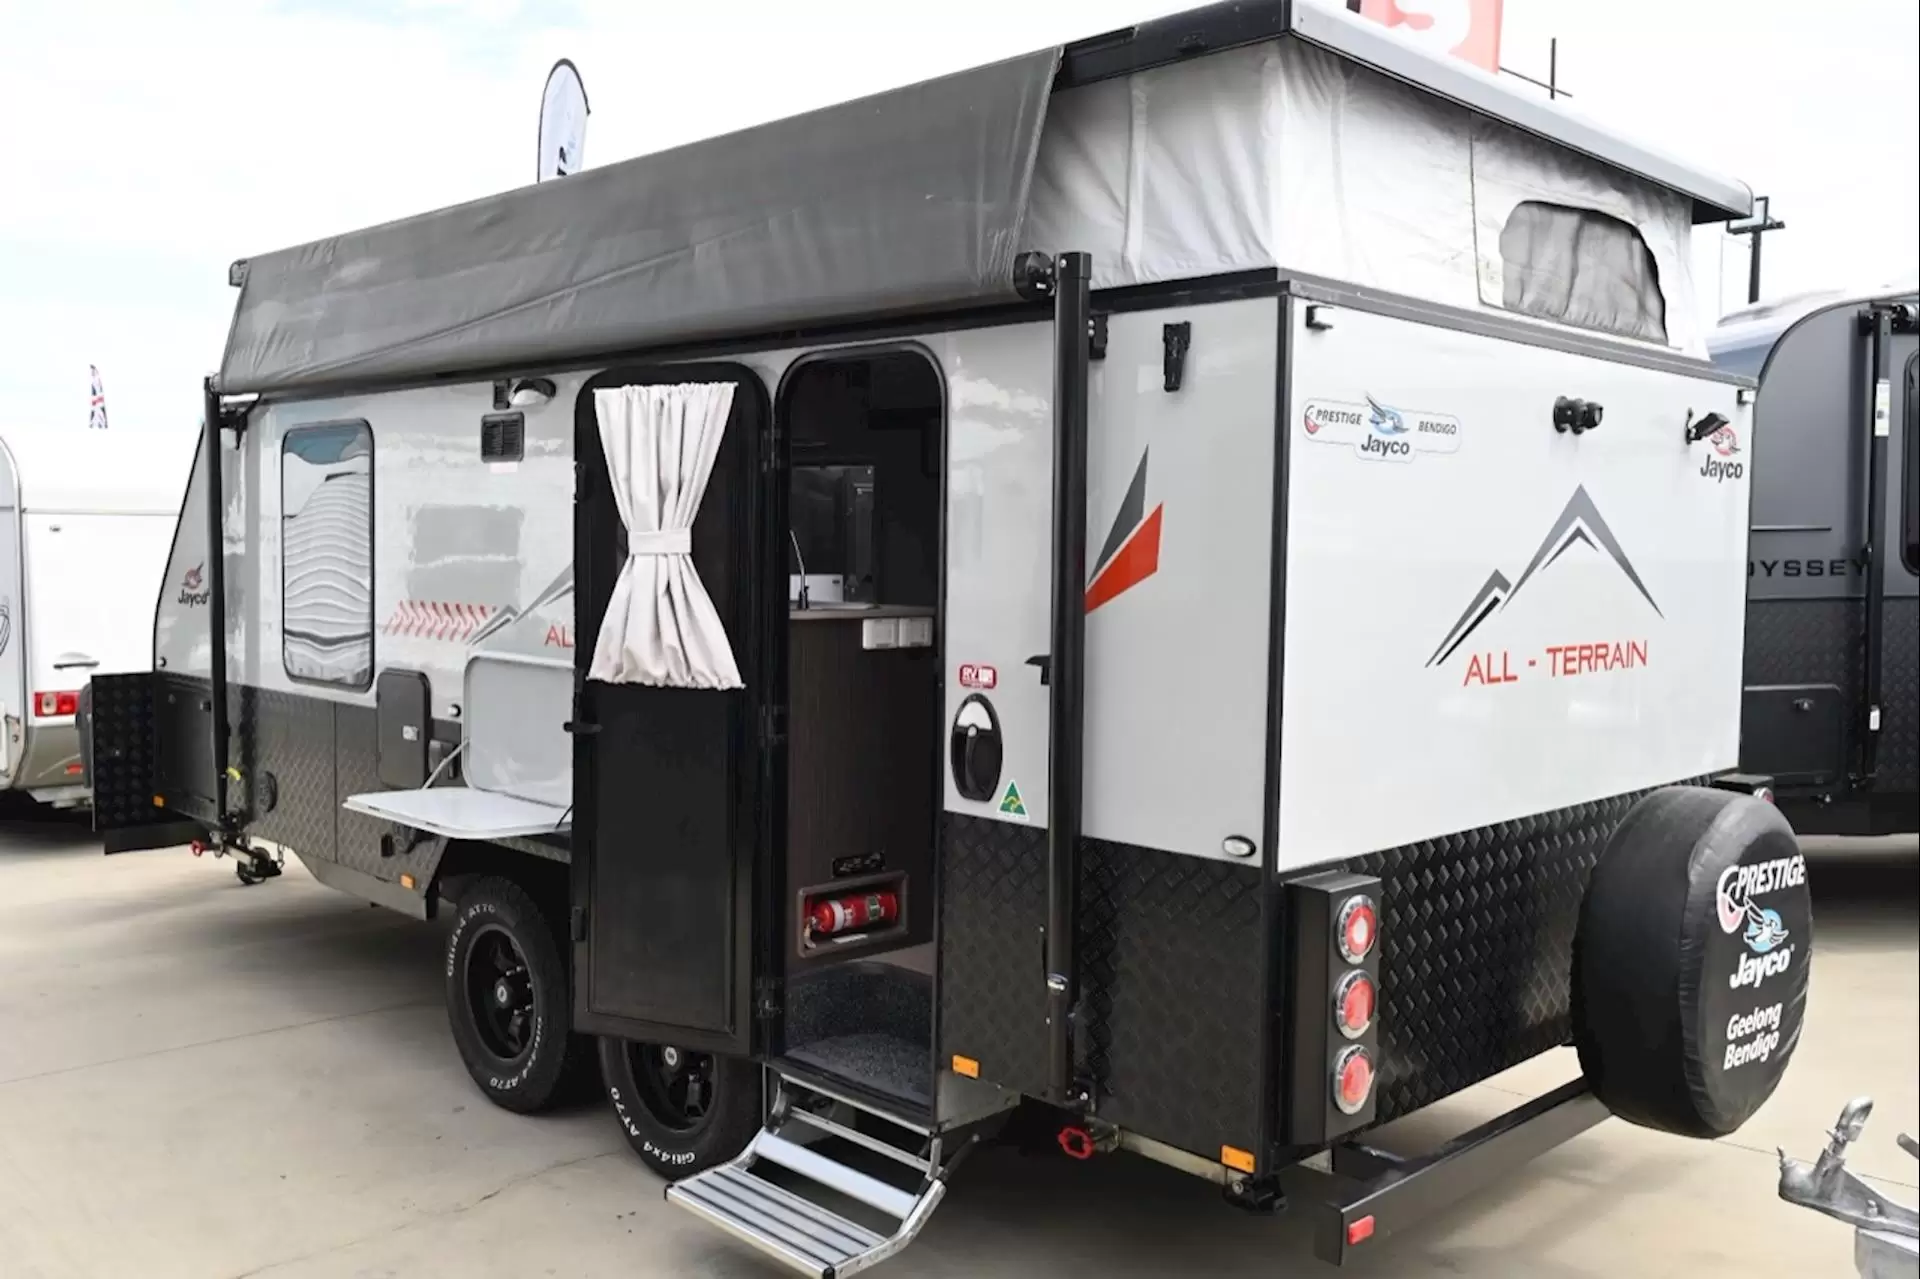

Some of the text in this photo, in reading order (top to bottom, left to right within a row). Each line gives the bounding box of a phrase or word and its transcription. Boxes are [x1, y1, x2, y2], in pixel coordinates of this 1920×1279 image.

[1315, 409, 1363, 426] PRESTIGE
[1418, 421, 1457, 436] BENDIGO
[1361, 433, 1410, 457] Jayco
[1700, 454, 1743, 483] Jayco
[178, 588, 208, 609] Jayco
[544, 625, 574, 648] AL
[1463, 651, 1518, 687] ALL
[1546, 640, 1648, 678] TERRAIN
[1735, 854, 1805, 900] PRESTIGE
[1730, 947, 1792, 989] Jayco
[1726, 1003, 1783, 1041] Geelong
[1723, 1031, 1780, 1071] Bendigo
